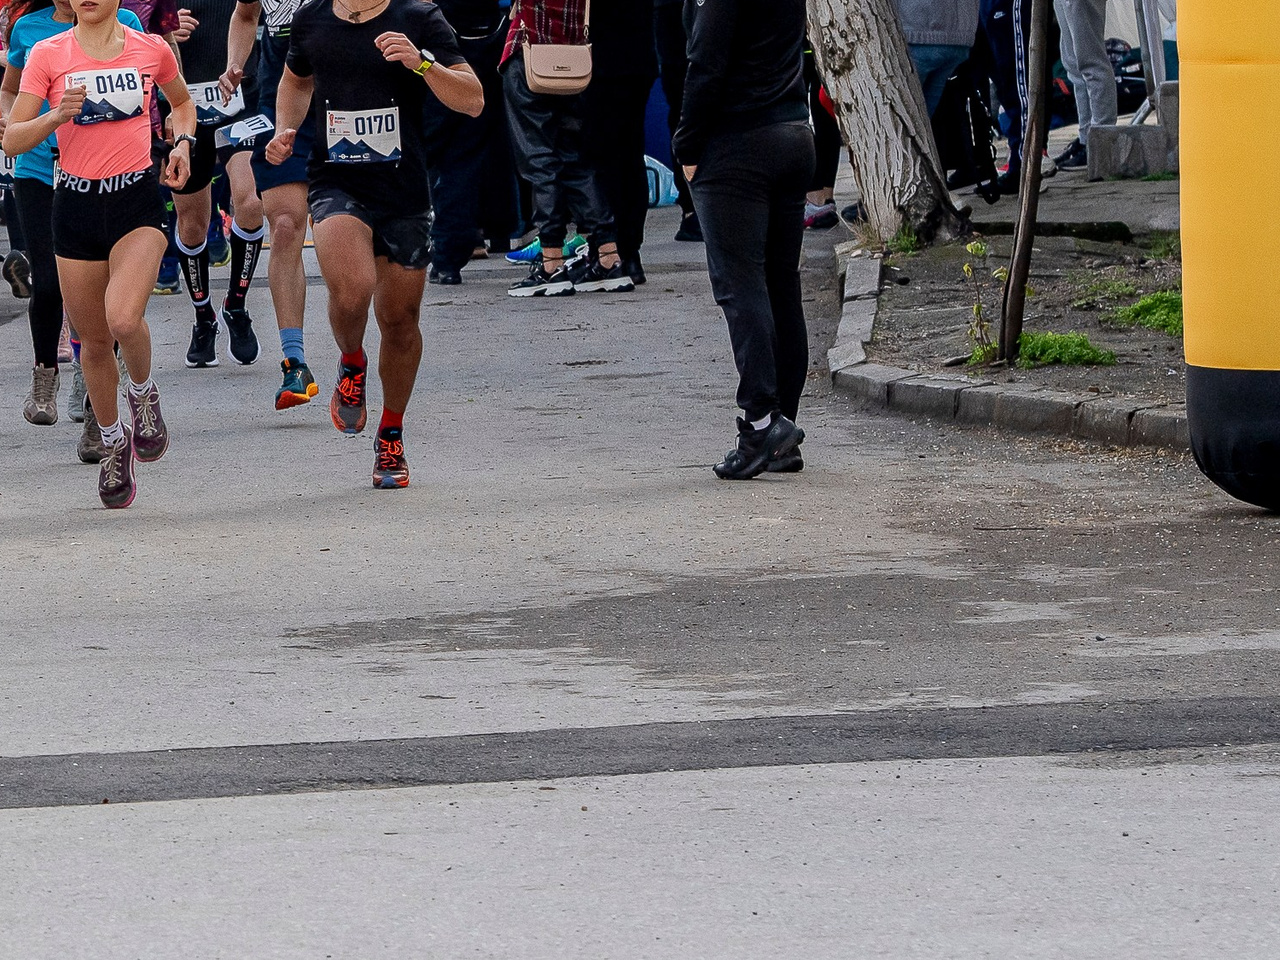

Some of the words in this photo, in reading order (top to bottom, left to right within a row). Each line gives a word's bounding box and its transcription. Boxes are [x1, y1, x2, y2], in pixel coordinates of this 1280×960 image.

[95, 72, 138, 95] 0148
[355, 113, 395, 135] 0170
[59, 170, 91, 193] PRO
[98, 169, 146, 194] NIKE
